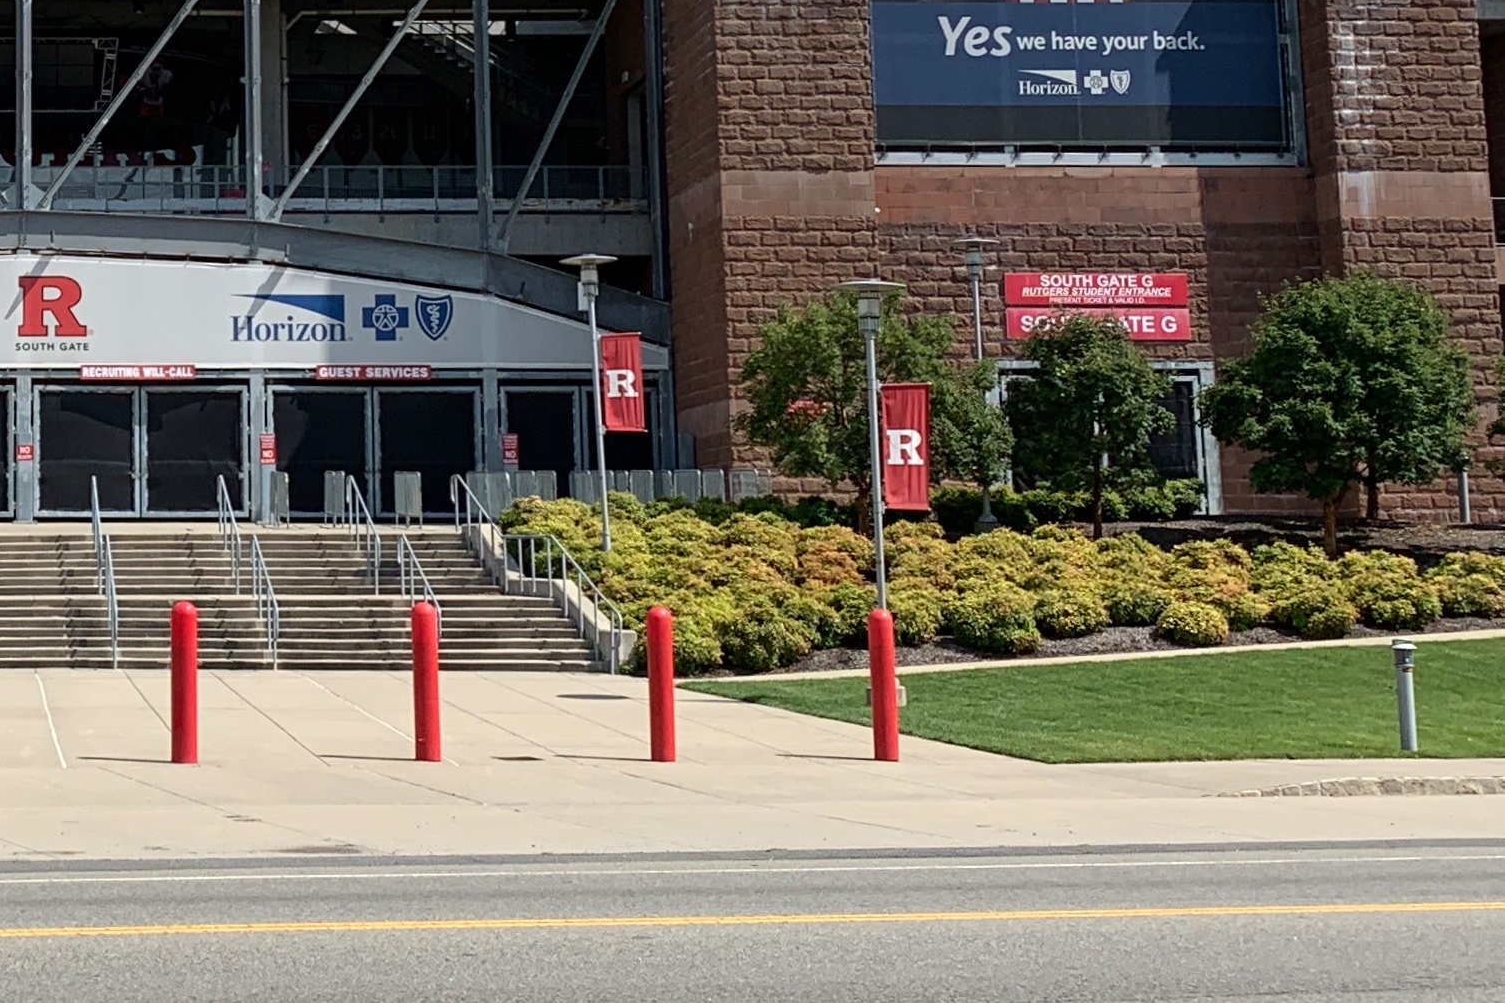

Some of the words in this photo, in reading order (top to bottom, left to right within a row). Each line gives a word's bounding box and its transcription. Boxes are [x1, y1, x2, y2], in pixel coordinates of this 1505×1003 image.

[938, 16, 1013, 57] Yes
[1016, 35, 1045, 50] we
[1051, 30, 1098, 50] have
[1102, 35, 1148, 55] your
[1153, 30, 1205, 50] back.
[1018, 80, 1077, 95] Horizon
[1040, 274, 1095, 287] SOUTH
[1097, 274, 1138, 287] GATE
[1141, 274, 1154, 287] G
[1022, 287, 1070, 296] RUTGERS
[1072, 287, 1118, 296] STUDENT
[1118, 287, 1172, 296] ENTRANCE
[18, 275, 88, 337] R
[230, 315, 347, 343] Horizon
[1161, 315, 1178, 333] G
[15, 343, 55, 351] SOUTH
[59, 343, 89, 351] GATE
[82, 366, 140, 377] RECRUITING
[142, 366, 194, 377] WILL-CALL
[319, 367, 361, 377] GUEST
[365, 367, 429, 377] SERVICES
[605, 368, 639, 398] R
[505, 450, 516, 459] NO
[886, 429, 924, 465] R
